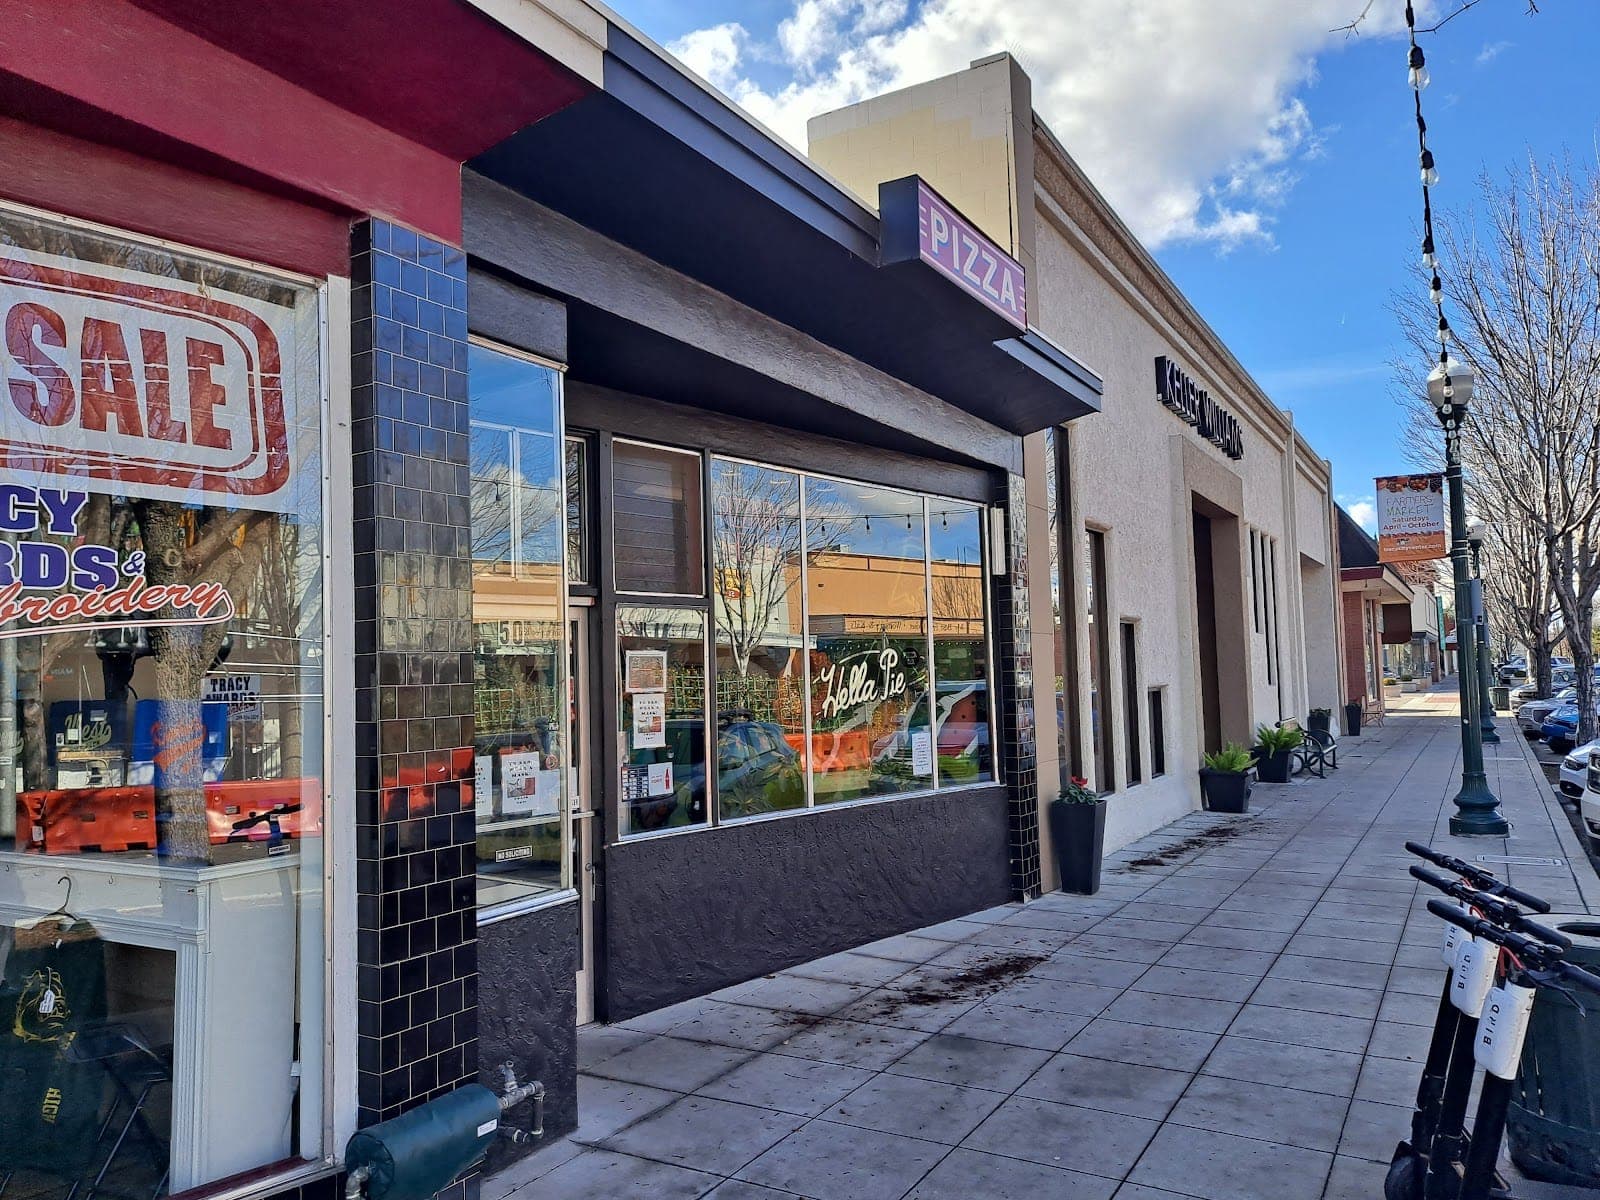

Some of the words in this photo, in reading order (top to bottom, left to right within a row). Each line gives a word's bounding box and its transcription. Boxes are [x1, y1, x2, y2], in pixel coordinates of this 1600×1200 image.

[931, 207, 1017, 312] PIZZA
[5, 302, 233, 451] SALE
[1386, 503, 1434, 517] MARKET
[1391, 515, 1430, 524] Saturdays
[1383, 523, 1402, 531] April
[1407, 521, 1440, 529] October
[121, 550, 146, 576] &
[210, 676, 251, 692] TRACY
[820, 662, 879, 719] Hella
[879, 647, 906, 700] Pie
[1446, 926, 1458, 949] BIR
